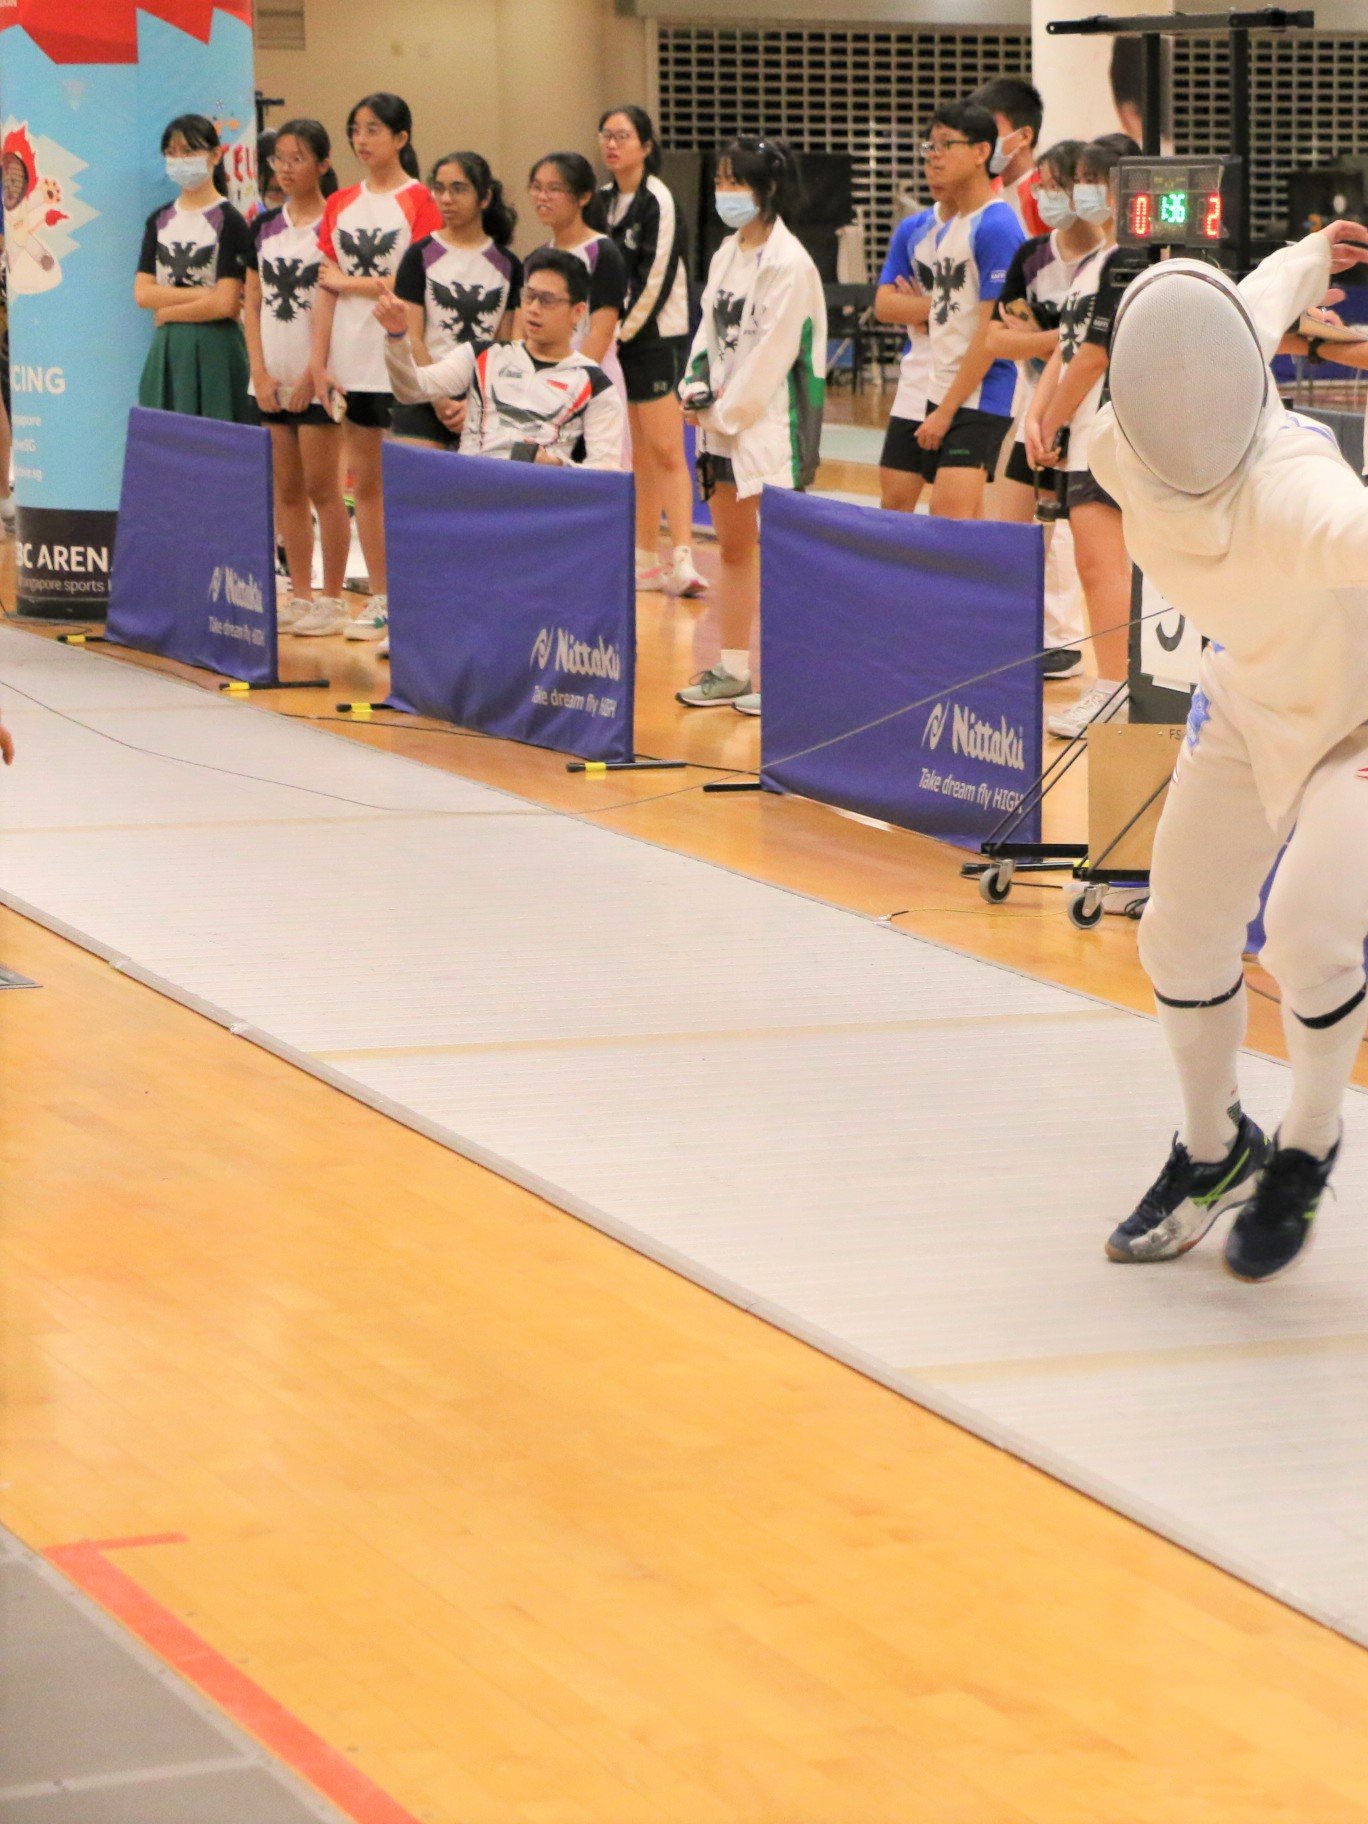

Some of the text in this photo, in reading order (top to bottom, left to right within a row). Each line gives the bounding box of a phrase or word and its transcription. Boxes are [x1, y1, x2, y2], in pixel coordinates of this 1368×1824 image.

[1134, 195, 1149, 236] 0
[1206, 195, 1221, 236] 2
[37, 544, 113, 573] AREN
[64, 580, 105, 595] sports
[919, 767, 942, 792] Take
[941, 773, 976, 802] dream
[976, 782, 992, 811] fly
